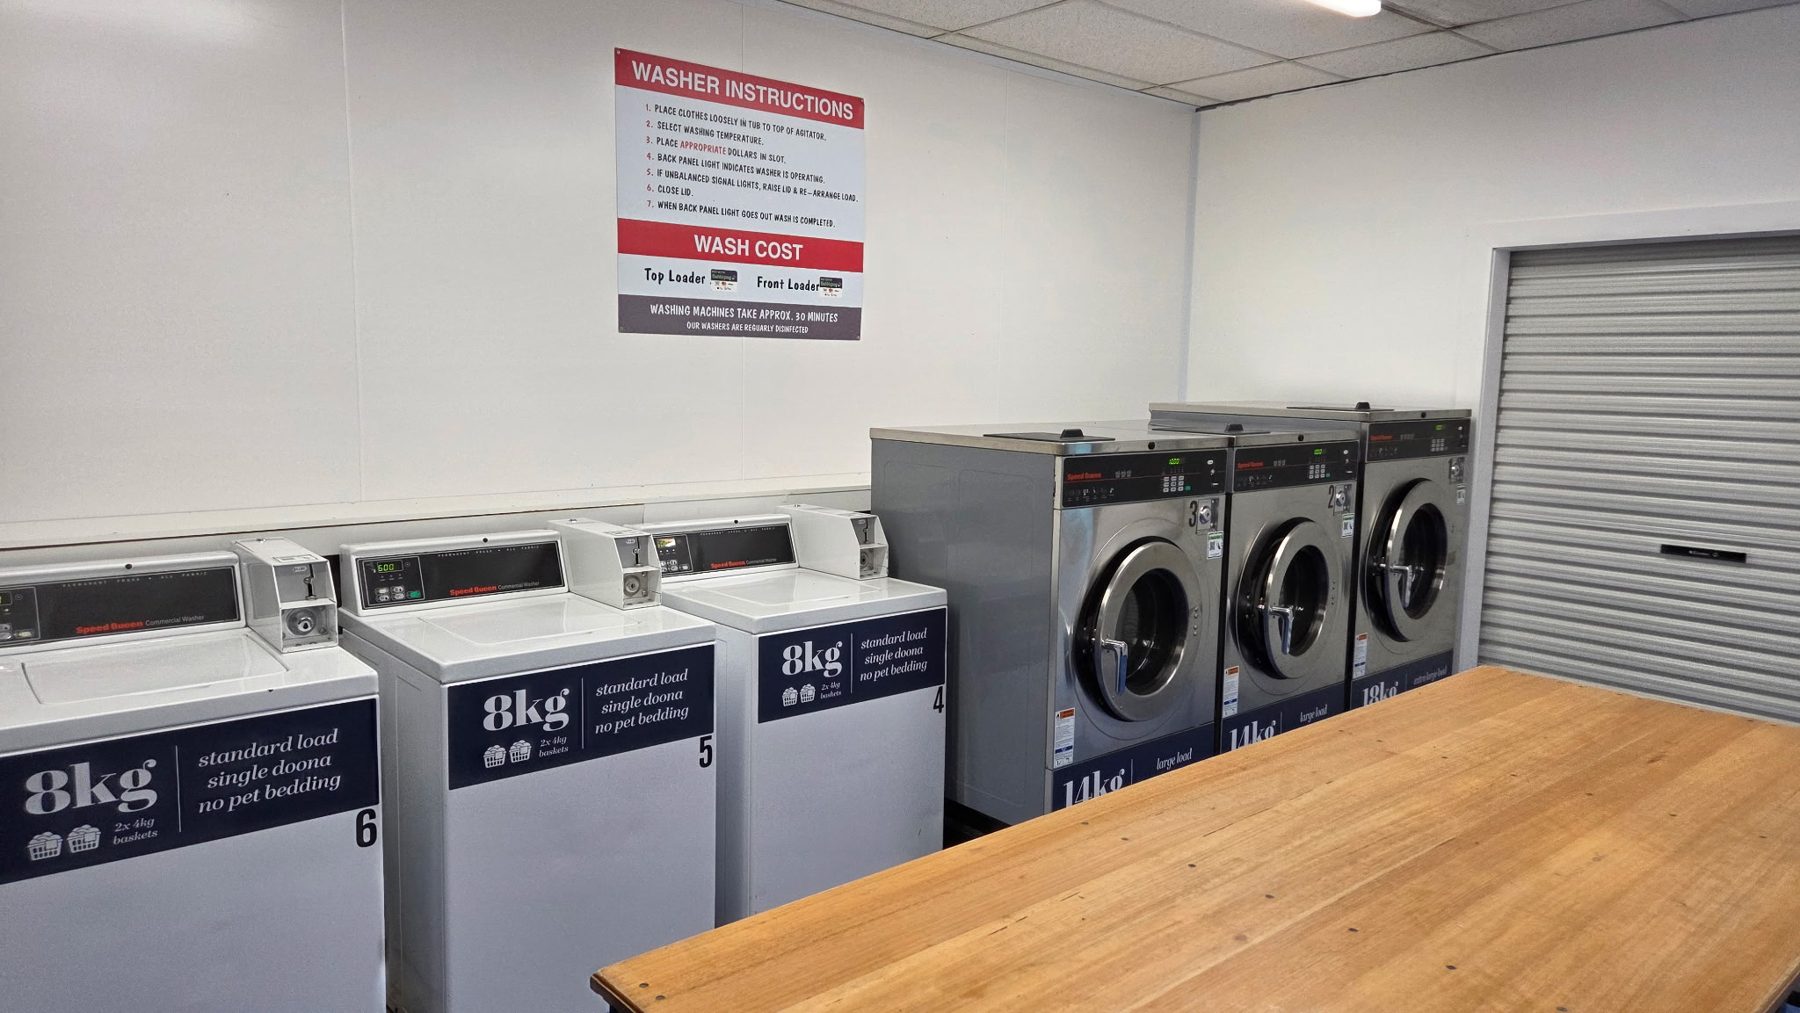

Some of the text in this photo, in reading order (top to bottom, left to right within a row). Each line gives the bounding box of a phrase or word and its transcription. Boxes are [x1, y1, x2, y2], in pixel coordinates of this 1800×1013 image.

[631, 60, 853, 120] WASHER INSTRUCTIONS
[646, 120, 764, 146] 2. SELECT WASHING TEMPERATURE.
[654, 104, 676, 116] PLACE
[678, 108, 708, 121] CLOTHES
[709, 114, 738, 127] LOOSELY
[740, 118, 746, 127] IN
[748, 120, 761, 129] TUB
[762, 123, 771, 131] TO
[773, 124, 784, 133] TOP
[786, 126, 794, 135] OF
[795, 128, 827, 141] AGITATOR.
[646, 136, 786, 164] 3. PLACE APPROPRIATE DOLLARS IN SLOT.
[646, 152, 825, 184] 4. BACK PANEL LIGHT INDICATES WASHER IS OPERATING.
[646, 168, 654, 177] 5.
[656, 168, 663, 177] IF
[665, 170, 710, 183] UNBALANCED
[711, 176, 735, 187] SIGNAL
[737, 179, 761, 191] LIGHTS,
[763, 183, 781, 192] RAISE
[782, 185, 791, 194] LID
[841, 193, 859, 202] LOAD.
[646, 184, 694, 197] 6. CLOSE LID.
[647, 200, 836, 228] 7. WHEN BACK PANEL LIGHT GOES OUT WASH IS COMPLETED.
[694, 234, 803, 260] WASH COST
[644, 268, 664, 285] Top
[669, 269, 706, 285] Loader
[757, 276, 784, 289] Front
[788, 278, 820, 292] Loader
[650, 304, 839, 322] WASHING MACHINES TAKE APPROX. 30 MINUTES
[686, 321, 809, 334] OUR WASHERS ARE REGUARLY DISINFECTED
[1328, 485, 1334, 509] 2
[1189, 500, 1198, 527] 3
[449, 588, 474, 596] Speed
[75, 615, 204, 635] Speed Queen Commercial Washer
[860, 627, 928, 650] standard load
[781, 640, 843, 678] 8kg
[865, 646, 923, 665] single doona
[595, 669, 689, 697] standard load
[860, 659, 928, 682] no pet bedding
[483, 687, 570, 732] 8kg
[601, 689, 683, 714] single doona
[933, 686, 944, 714] 4
[595, 705, 689, 735] no pet bedding
[198, 728, 339, 768] standard load
[539, 746, 569, 758] baskets
[540, 736, 567, 747] 2x 4kg
[699, 735, 713, 768] 5
[207, 755, 332, 789] single doona
[1156, 747, 1193, 771] large load
[24, 758, 158, 815] 8kg
[199, 773, 341, 814] no pet bedding
[113, 828, 158, 846] baskets
[115, 816, 156, 833] 2x 4kg
[355, 808, 378, 848] 6
